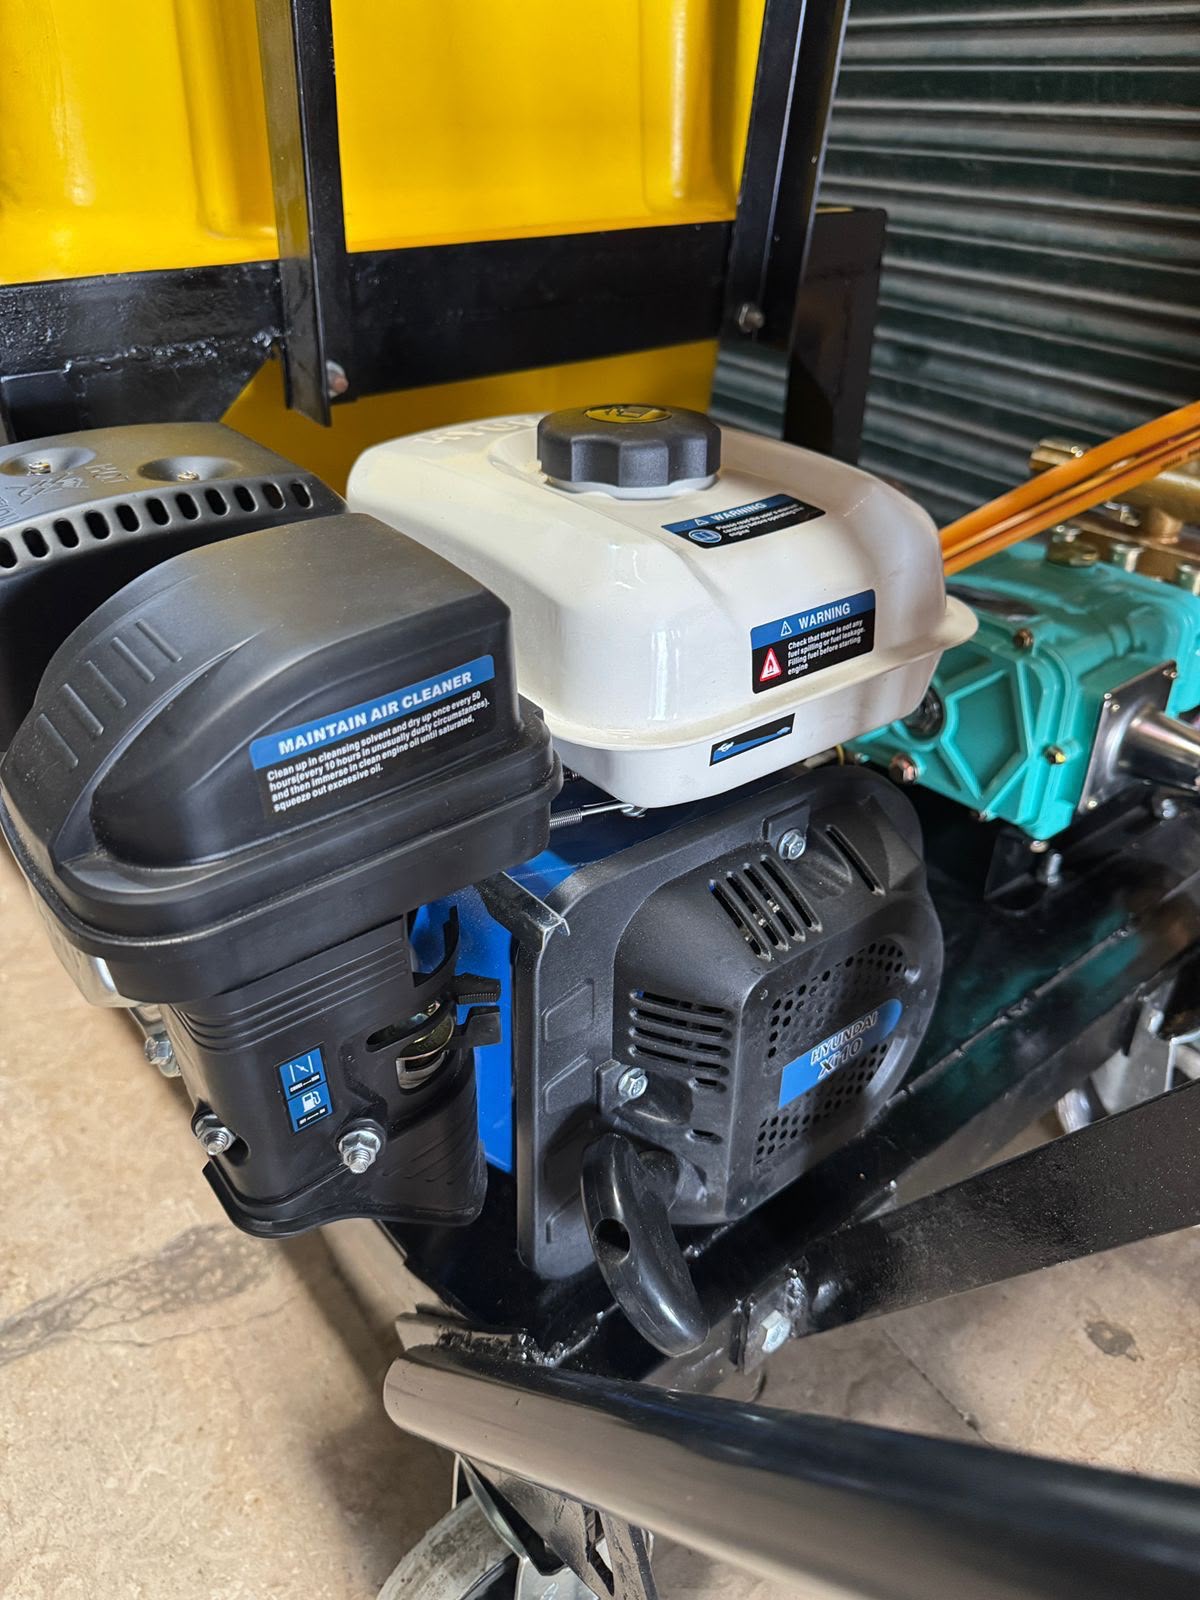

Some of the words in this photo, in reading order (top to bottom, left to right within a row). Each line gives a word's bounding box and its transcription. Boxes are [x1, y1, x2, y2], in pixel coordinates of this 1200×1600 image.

[711, 502, 768, 522] WARNING
[788, 637, 807, 650] Check
[807, 633, 820, 644] that
[820, 629, 835, 639] there
[836, 626, 842, 634] is
[842, 622, 852, 631] not
[852, 619, 863, 628] any
[798, 602, 851, 630] WARNING
[787, 648, 800, 659] fuel
[800, 641, 822, 654] spilling
[830, 633, 842, 643] fuel
[842, 627, 866, 639] leakage.
[788, 655, 807, 667] Filling
[807, 649, 819, 660] fuel
[820, 644, 838, 656] before
[839, 636, 861, 649] starting
[787, 663, 808, 675] engine
[278, 712, 367, 755] MAINTAIN
[371, 701, 400, 721] AIR
[401, 671, 472, 709] CLEANER
[267, 765, 294, 781] Clean
[295, 761, 307, 772] up
[308, 757, 317, 767] in
[318, 741, 360, 763] cleansing
[360, 728, 391, 747] solvent
[391, 722, 407, 734] and
[408, 717, 421, 728] dry
[421, 712, 431, 723] up
[432, 704, 451, 717] once
[451, 696, 471, 710] every
[472, 690, 481, 701] 50
[269, 766, 323, 792] hours(every
[325, 760, 335, 771] 10
[336, 751, 361, 767] hours
[362, 748, 370, 757] in
[371, 731, 410, 753] unusually
[411, 723, 432, 737] dusty
[433, 698, 490, 727] circumstances).
[272, 787, 289, 802] and
[290, 781, 311, 796] then
[311, 767, 349, 788] immerse
[349, 763, 357, 772] in
[358, 754, 381, 768] clean
[381, 741, 408, 759] engine
[409, 737, 419, 748] oil
[420, 730, 437, 744] until
[438, 714, 474, 736] saturated,
[274, 792, 311, 812] squeeze
[311, 785, 327, 798] out
[327, 769, 369, 792] excessive
[370, 763, 383, 775] oil.
[811, 1011, 878, 1066] HYUNDAI
